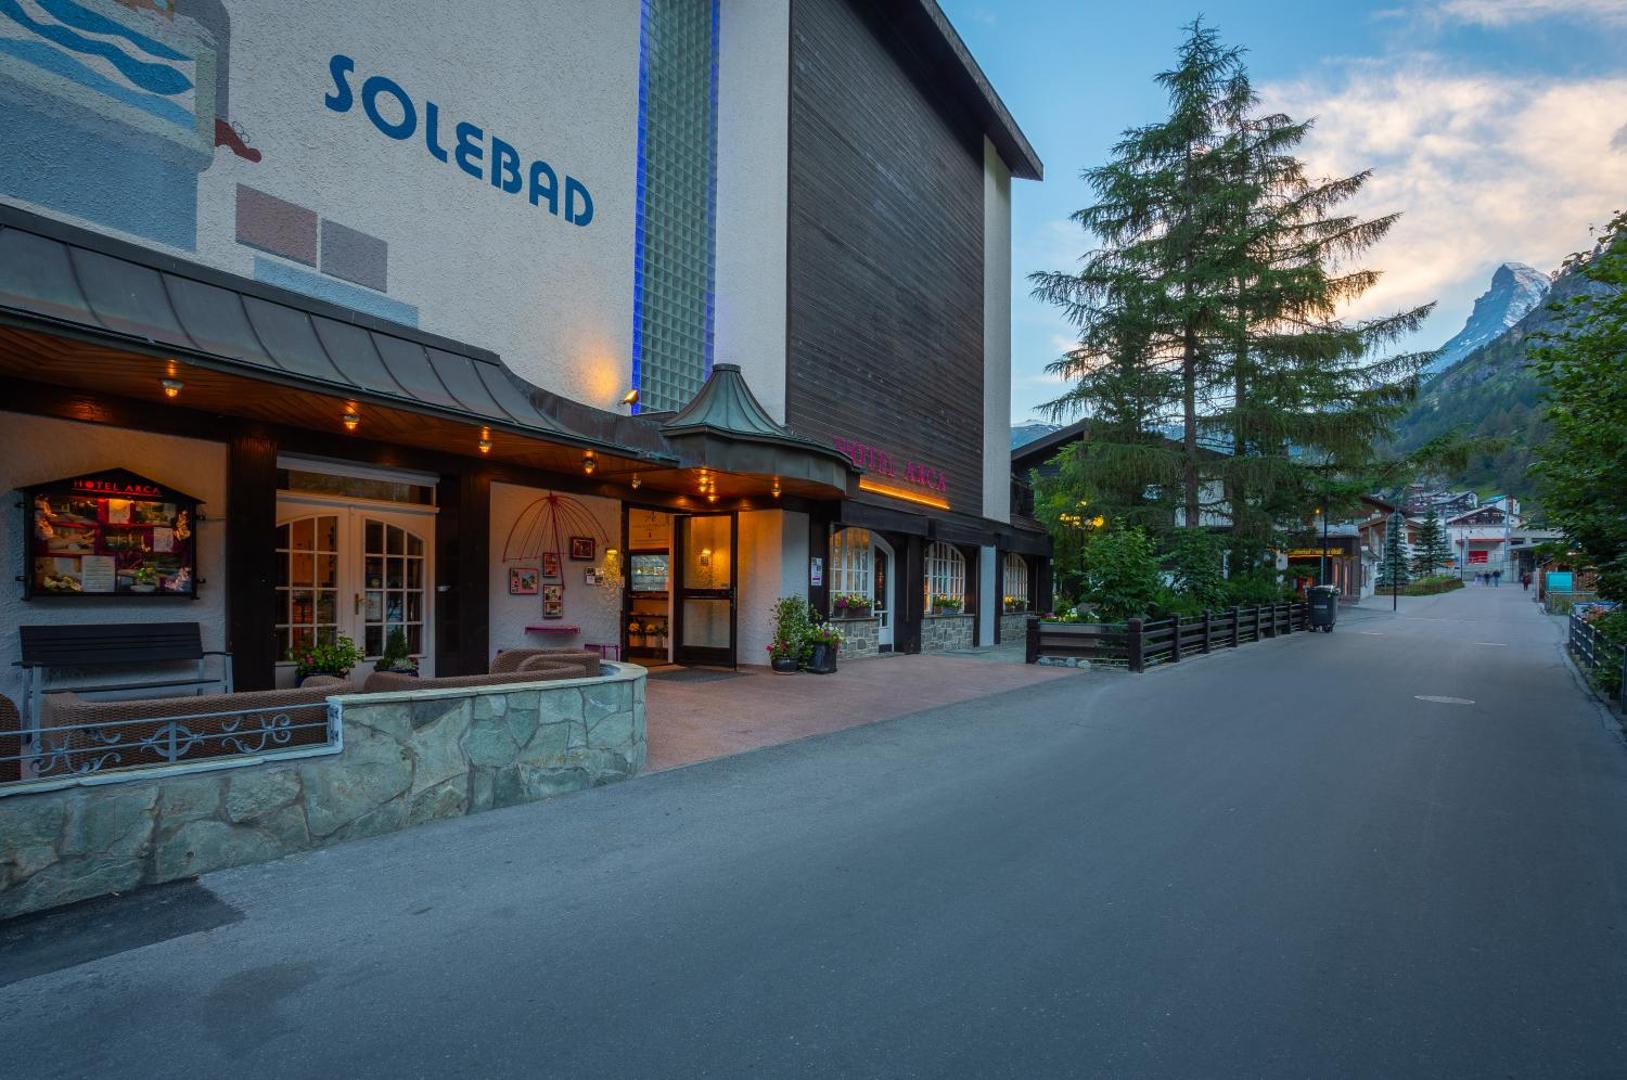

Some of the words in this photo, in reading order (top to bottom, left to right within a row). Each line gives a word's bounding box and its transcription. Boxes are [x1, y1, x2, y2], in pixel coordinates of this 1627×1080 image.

[324, 54, 594, 227] SOLEBAD
[73, 480, 119, 491] HOTEL
[125, 484, 160, 495] ARCA
